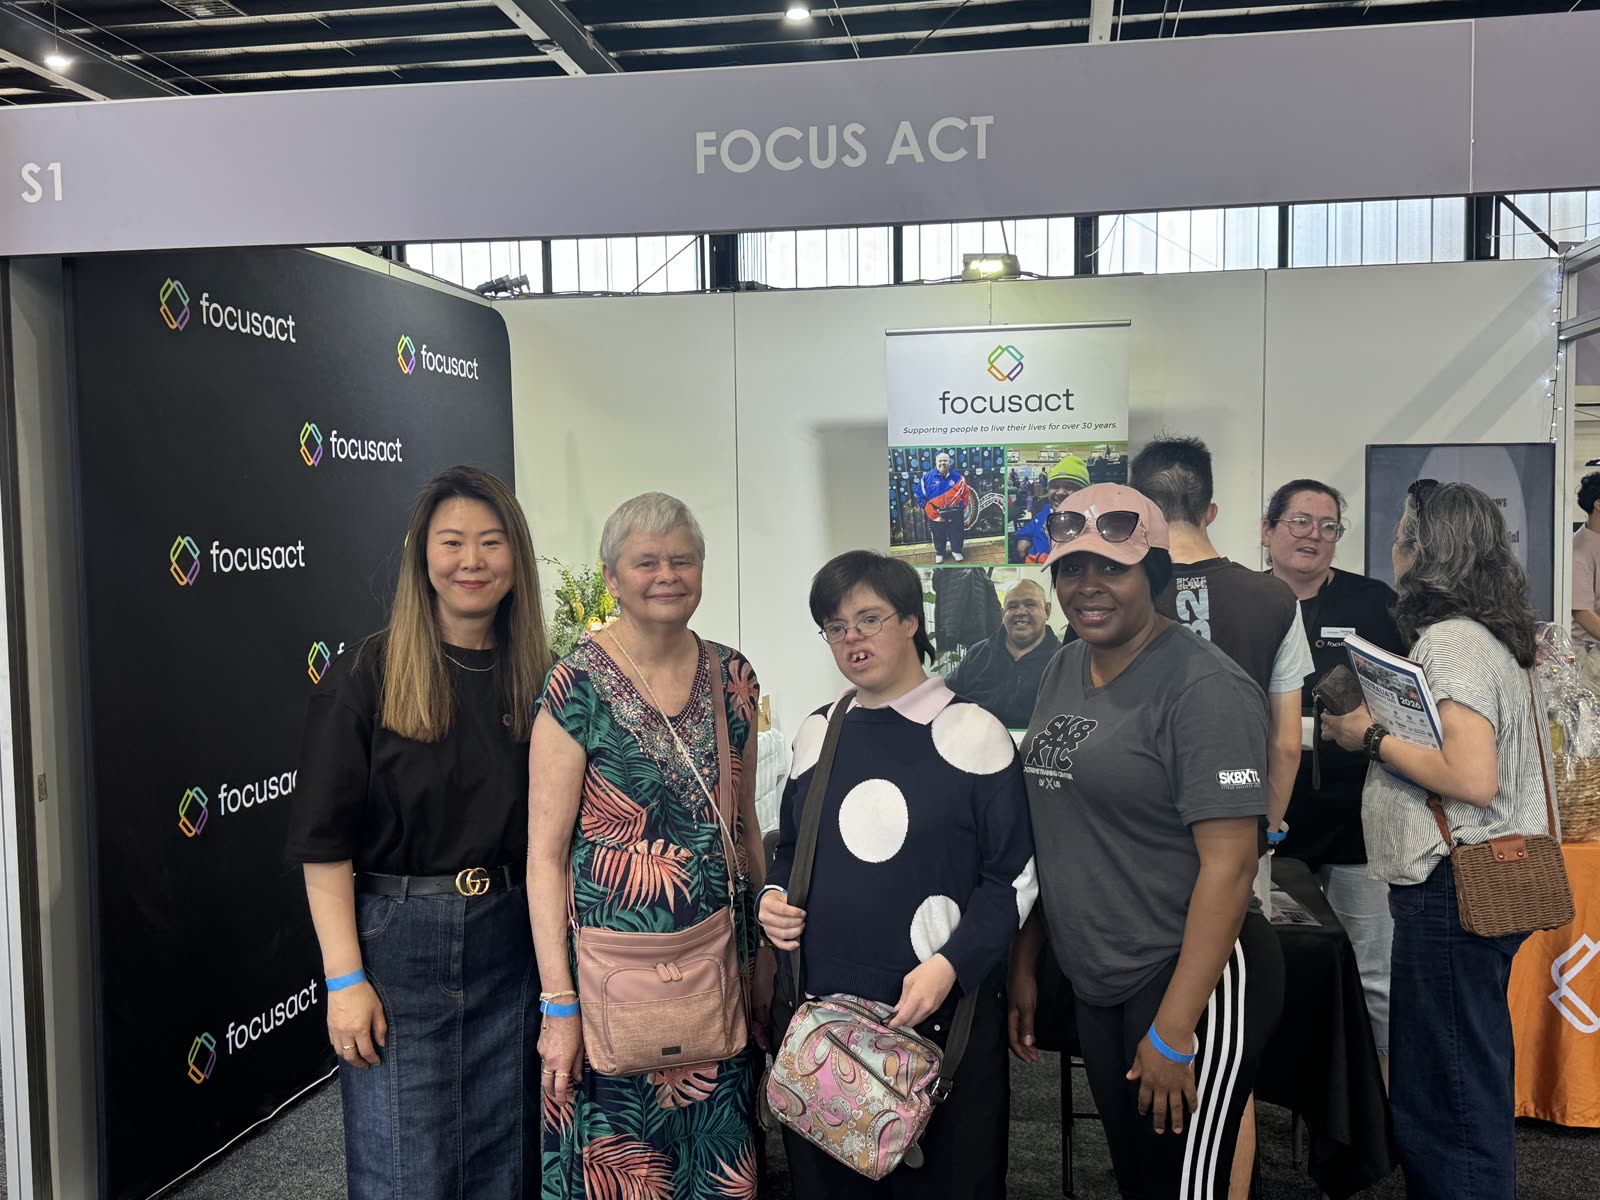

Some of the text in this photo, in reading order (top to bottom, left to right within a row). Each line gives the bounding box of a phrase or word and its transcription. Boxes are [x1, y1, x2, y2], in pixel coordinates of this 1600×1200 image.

[695, 115, 994, 174] FOCUS ACT
[21, 162, 63, 203] S1
[199, 292, 297, 344] focusact
[420, 343, 479, 381] focusact
[938, 388, 1075, 415] focusact
[329, 429, 403, 463] focusact
[903, 426, 948, 435] Supporting
[949, 425, 979, 435] people
[990, 424, 1005, 432] live
[1007, 423, 1026, 432] their
[1028, 423, 1046, 431] lives
[1048, 422, 1060, 431] for
[1094, 421, 1118, 431] years.
[209, 539, 306, 573] focusact
[217, 769, 298, 816] focusa
[225, 978, 318, 1055] focusact
